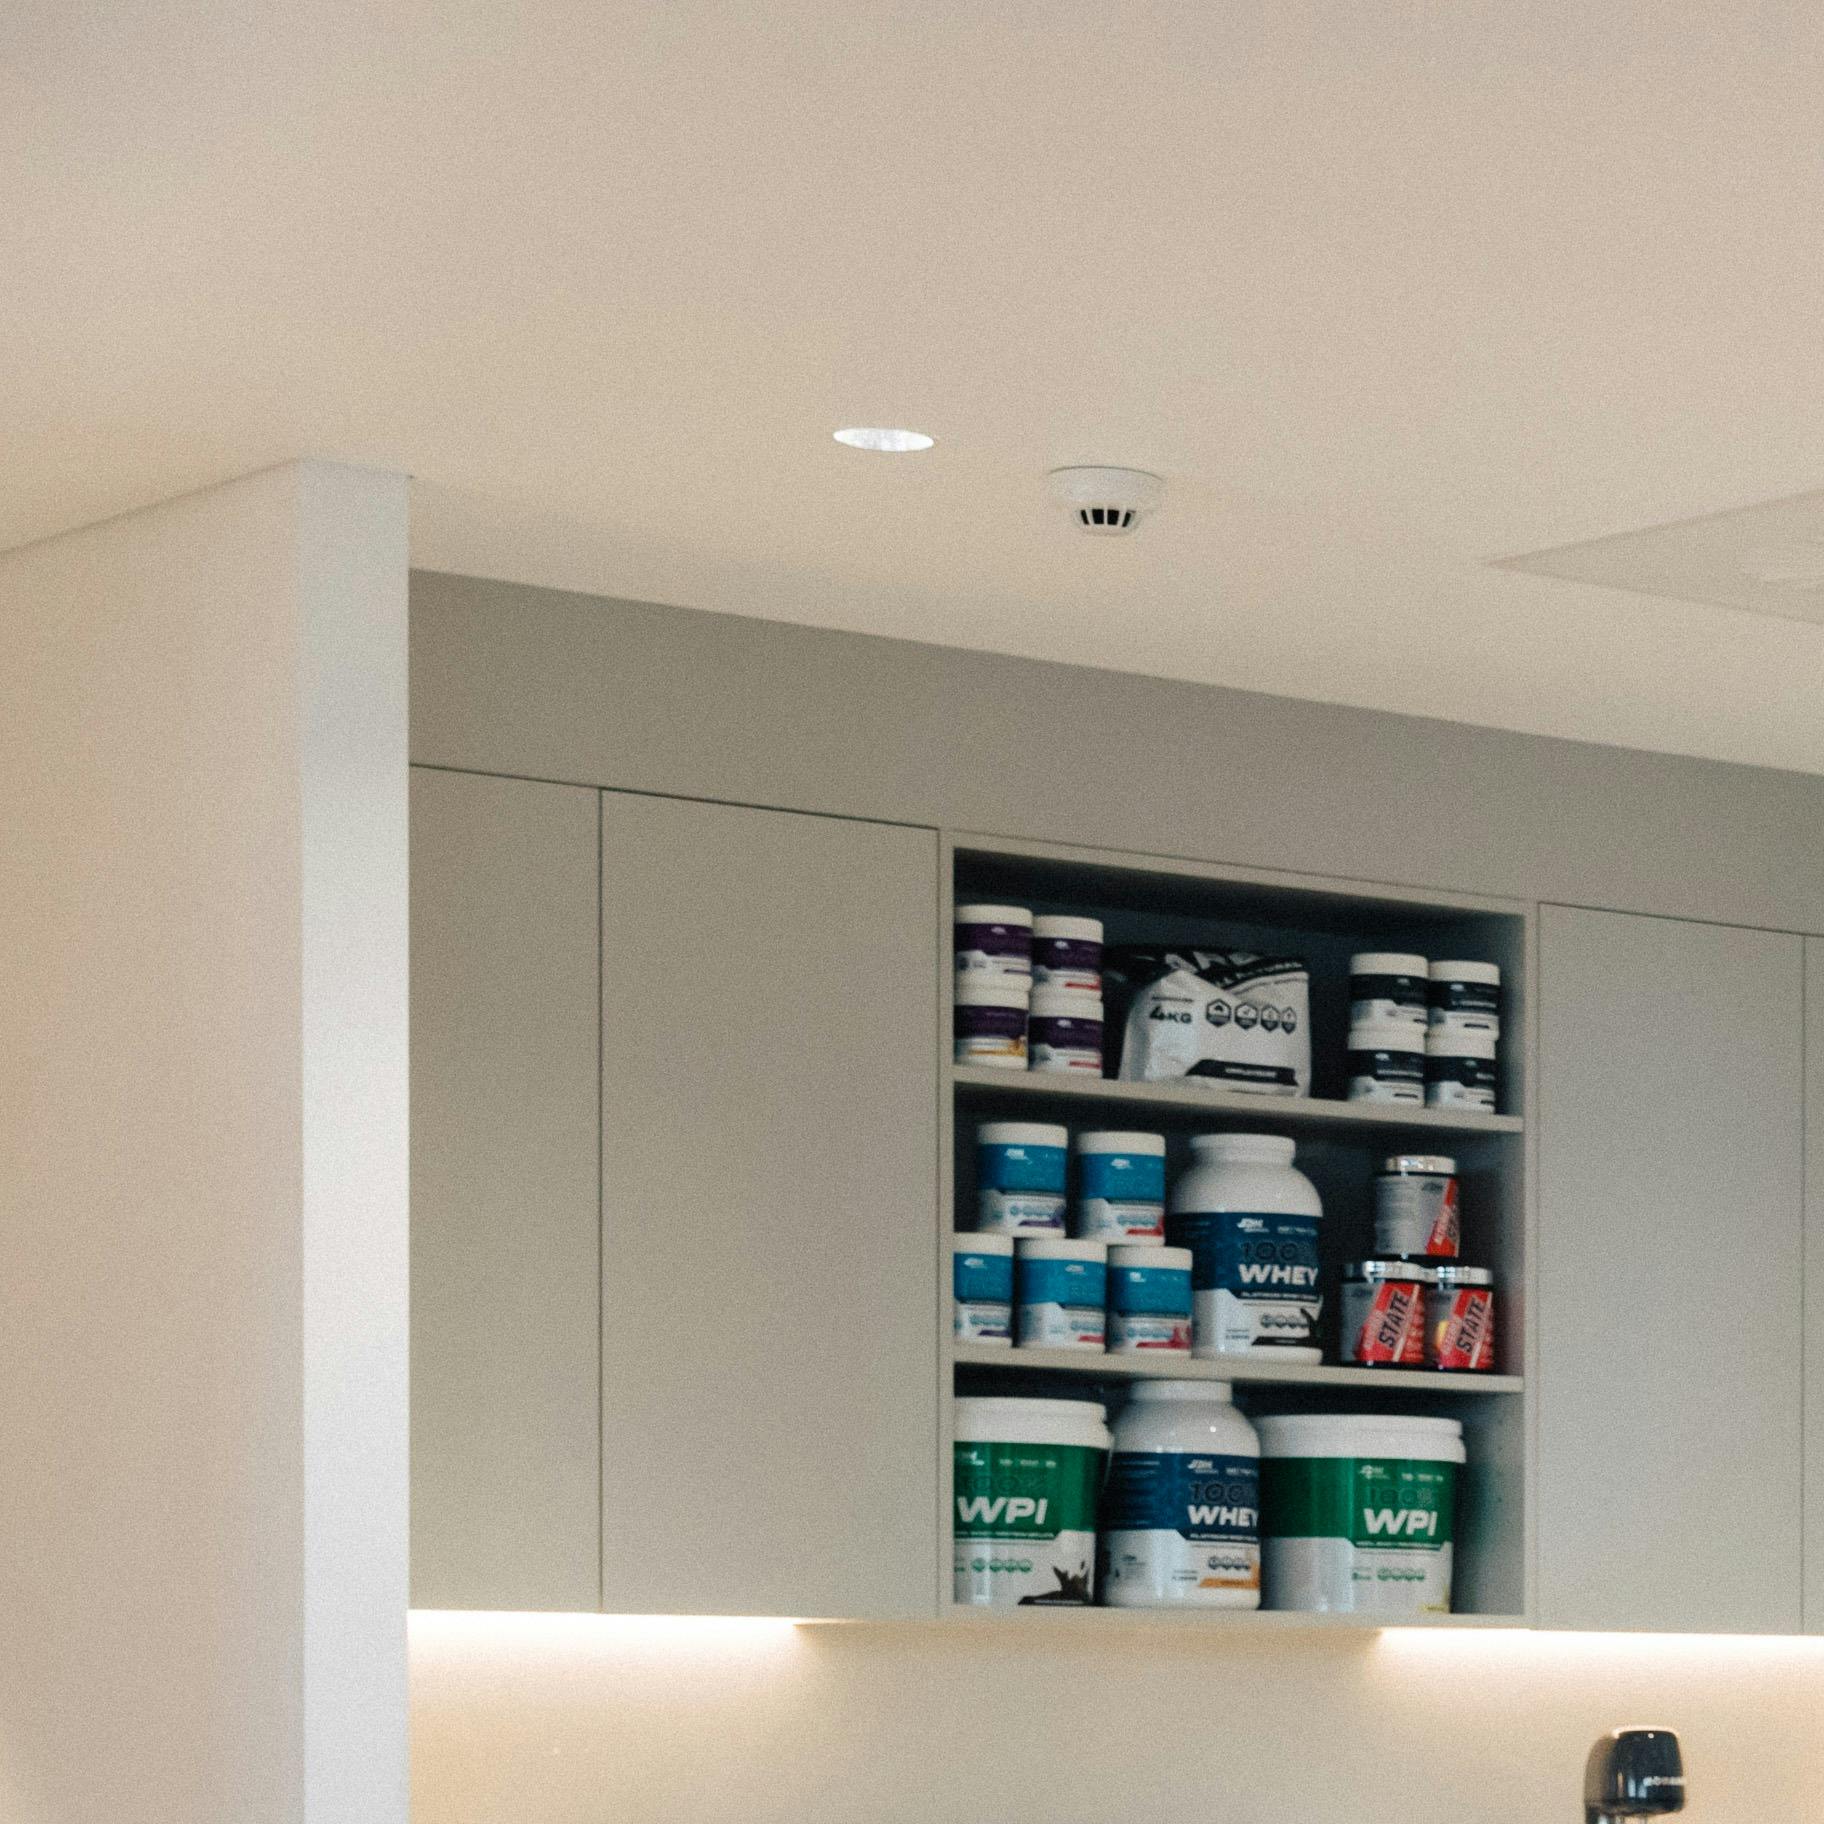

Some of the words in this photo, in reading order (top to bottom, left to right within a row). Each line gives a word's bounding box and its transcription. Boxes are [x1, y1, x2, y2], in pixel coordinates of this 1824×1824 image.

[1238, 1264, 1318, 1285] WHEY
[957, 1496, 1048, 1525] WPI
[1363, 1508, 1438, 1536] WPI
